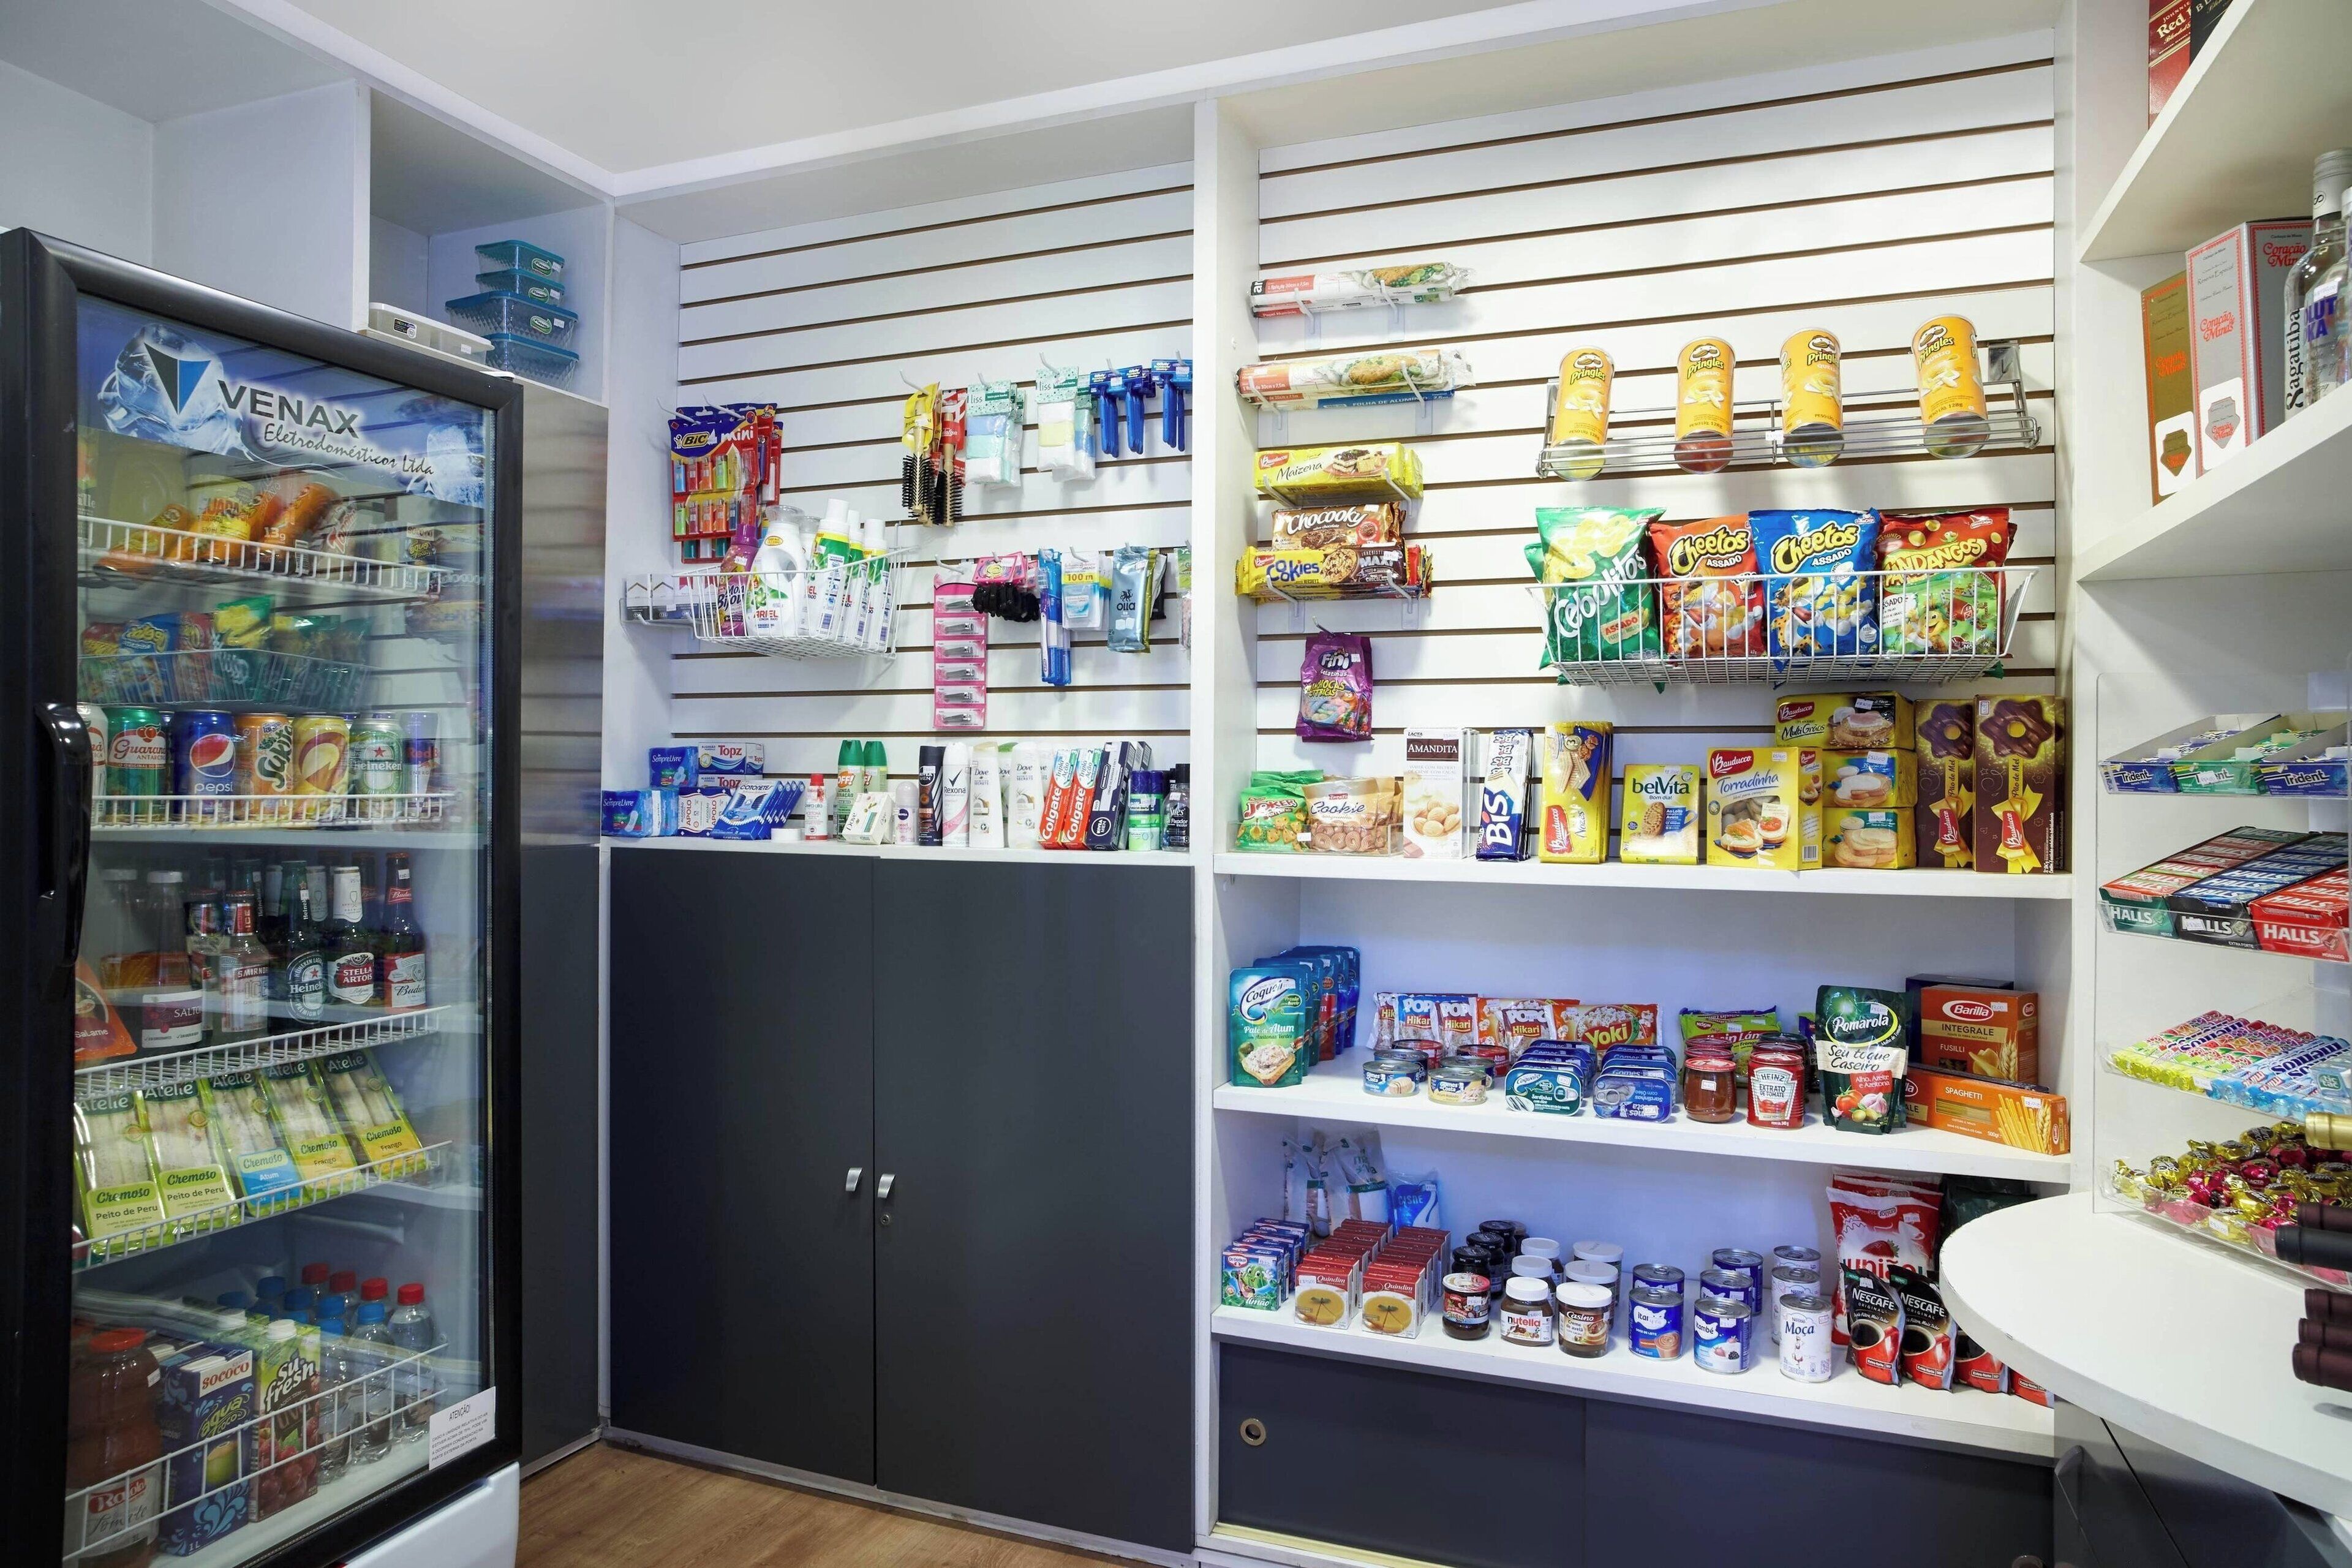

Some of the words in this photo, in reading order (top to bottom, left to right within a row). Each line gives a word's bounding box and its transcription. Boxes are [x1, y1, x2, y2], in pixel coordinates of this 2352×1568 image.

[2157, 13, 2185, 39] Red
[1919, 336, 1954, 370] Pringles
[2286, 309, 2304, 410] Sagatiba
[1687, 358, 1724, 379] Pringles
[1570, 368, 1605, 385] Pringles
[218, 379, 359, 439] VENAX
[721, 426, 753, 442] mini
[265, 423, 397, 468] Eletrodomésticos
[401, 454, 434, 475] Ltda
[1277, 461, 1322, 481] Maizena
[1287, 506, 1367, 534] Chocooky
[1671, 526, 1750, 576] Cheetos
[1774, 525, 1859, 572] Cheetos
[1706, 556, 1743, 568] ASSADO
[1811, 548, 1852, 567] ASSADO
[1266, 560, 1320, 581] Cookies
[1554, 543, 1647, 638] Cebolitos
[1117, 601, 1136, 611] olla
[1322, 651, 1349, 669] Fini
[1779, 704, 1813, 719] Bauducco
[718, 745, 742, 758] Topz
[1408, 743, 1458, 754] AMANDITA
[1712, 753, 1752, 773] Bauducco
[1717, 768, 1779, 795] Torradinha
[2015, 772, 2020, 782] de
[2121, 770, 2150, 783] Trident
[2285, 772, 2325, 785] Trident
[194, 781, 233, 794] pepsi
[1632, 774, 1691, 795] belVita
[1042, 787, 1062, 840] Colgate
[1066, 788, 1086, 840] Colgate
[1310, 801, 1365, 815] Cookie
[1551, 808, 1568, 852] Bauducco
[1943, 810, 1958, 843] Bauducco
[2005, 812, 2022, 847] Bauducco
[2226, 870, 2283, 880] HALLS
[2204, 878, 2261, 889] HALLS
[2180, 888, 2240, 899] HALLS
[2268, 895, 2328, 908] HALLS
[2110, 907, 2154, 924] HALLS
[2263, 924, 2321, 944] HALLS
[343, 967, 372, 976] STELLA
[343, 974, 372, 984] ARTOIS
[290, 982, 324, 994] Heinek
[1954, 1003, 1989, 1017] Barilla
[1445, 1020, 1471, 1029] Hikari
[1512, 1024, 1540, 1036] Hikari
[1833, 1014, 1889, 1033] Pomarola
[1941, 1023, 1994, 1036] INTEGRALE
[1585, 1023, 1629, 1047] Yoki
[1829, 1045, 1849, 1058] Seu
[1854, 1048, 1891, 1062] toque
[1940, 1043, 1966, 1053] FUSILLI
[1831, 1057, 1880, 1072] Caseiro
[2270, 1041, 2343, 1074] mentos
[1517, 1074, 1542, 1085] Coqueiro
[1760, 1073, 1785, 1082] HEINZ
[1759, 1084, 1787, 1093] EXTRATO
[1945, 1087, 1983, 1101] SPAGHETTI
[366, 1125, 402, 1142] Cremoso
[300, 1139, 337, 1155] Cremoso
[380, 1141, 402, 1152] Frango
[243, 1153, 283, 1170] Cremoso
[313, 1156, 337, 1167] Frango
[167, 1170, 216, 1186] Cremoso
[258, 1170, 279, 1182] Atum
[96, 1187, 150, 1204] Cremoso
[167, 1191, 190, 1202] Peito
[192, 1189, 203, 1199] de
[205, 1186, 225, 1196] Peru
[96, 1209, 121, 1220] Peito
[123, 1207, 135, 1217] de
[137, 1204, 158, 1215] Peru
[1317, 1275, 1346, 1284] Quindim
[1384, 1282, 1414, 1292] Quindim
[1858, 1302, 1887, 1314] ORIGINAL
[1907, 1308, 1936, 1320] ORIGINAL
[1507, 1314, 1541, 1328] nutella
[1567, 1311, 1594, 1322] Casino
[1785, 1321, 1815, 1335] Moça
